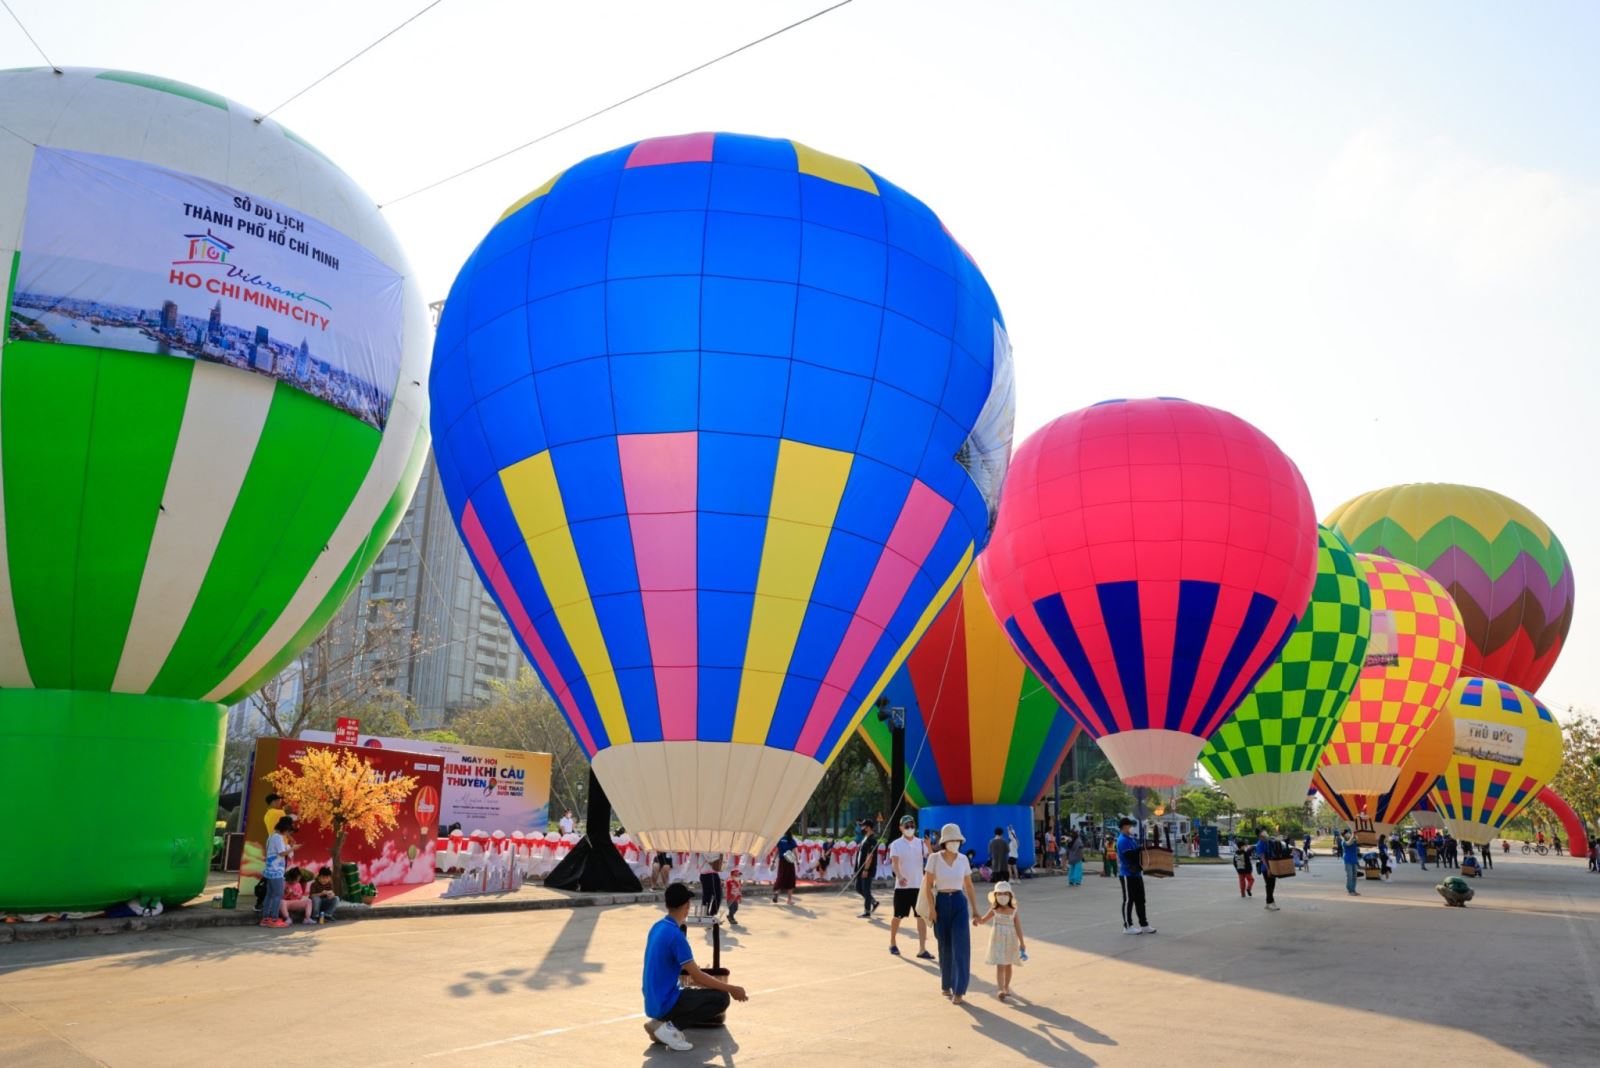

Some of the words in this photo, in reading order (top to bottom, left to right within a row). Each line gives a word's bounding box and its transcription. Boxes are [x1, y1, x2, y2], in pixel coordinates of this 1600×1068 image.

[183, 203, 233, 228] THÀNH
[237, 219, 267, 238] PHỐ
[268, 229, 286, 246] HỒ
[289, 237, 309, 257] CHÍ
[312, 247, 339, 271] MINH
[233, 196, 251, 212] SỞ
[255, 204, 273, 220] DU
[276, 212, 304, 233] LỊCH
[169, 269, 202, 289] HO
[206, 278, 240, 299] CHI
[243, 287, 290, 315] MINH
[291, 305, 330, 332] CITY
[227, 263, 331, 310] Vibrant
